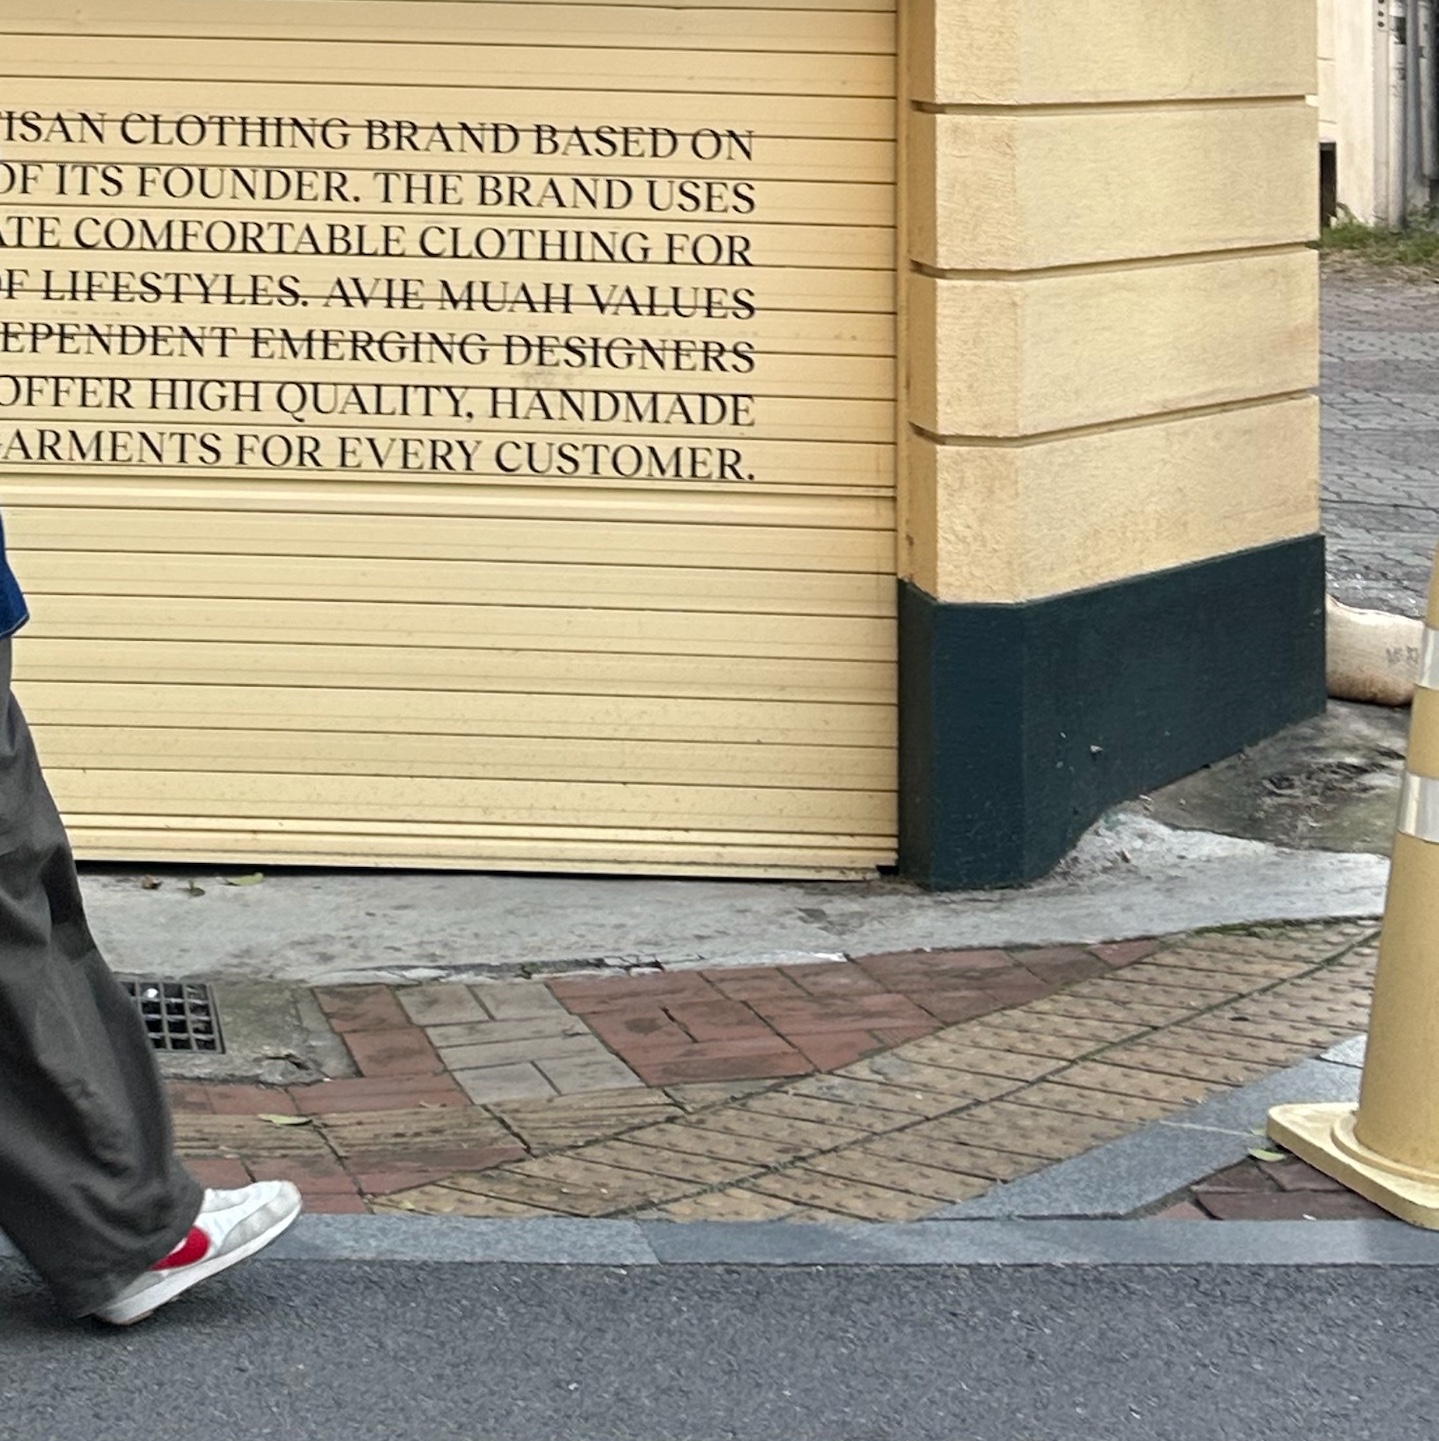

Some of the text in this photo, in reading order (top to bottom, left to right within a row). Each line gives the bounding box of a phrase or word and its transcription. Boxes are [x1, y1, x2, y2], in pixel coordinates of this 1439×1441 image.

[119, 112, 350, 150] CLOTHING
[365, 119, 520, 154] BRAND
[533, 124, 678, 159] BASED
[690, 127, 754, 161] ON
[55, 162, 123, 197] ITS
[137, 165, 361, 202] FOUNDER.
[374, 172, 464, 206] THE
[477, 175, 633, 211] BRAND
[647, 180, 757, 215] USES
[73, 217, 405, 257] COMFORTABLE
[419, 225, 652, 264] CLOTHING
[665, 232, 754, 268] FOR
[41, 269, 309, 308] LIFESTYLES.
[323, 276, 425, 310] AVIE
[438, 279, 573, 315] MUAH
[587, 283, 757, 320] VALUES
[251, 327, 489, 365] EMERGING
[503, 334, 757, 374] DESIGNERS
[148, 379, 262, 413] HIGH
[275, 381, 474, 423] QUALITY,
[488, 387, 756, 427] HANDMADE
[236, 434, 323, 469] FOR
[336, 437, 482, 472] EVERY
[493, 440, 756, 482] CUSTOMER.
